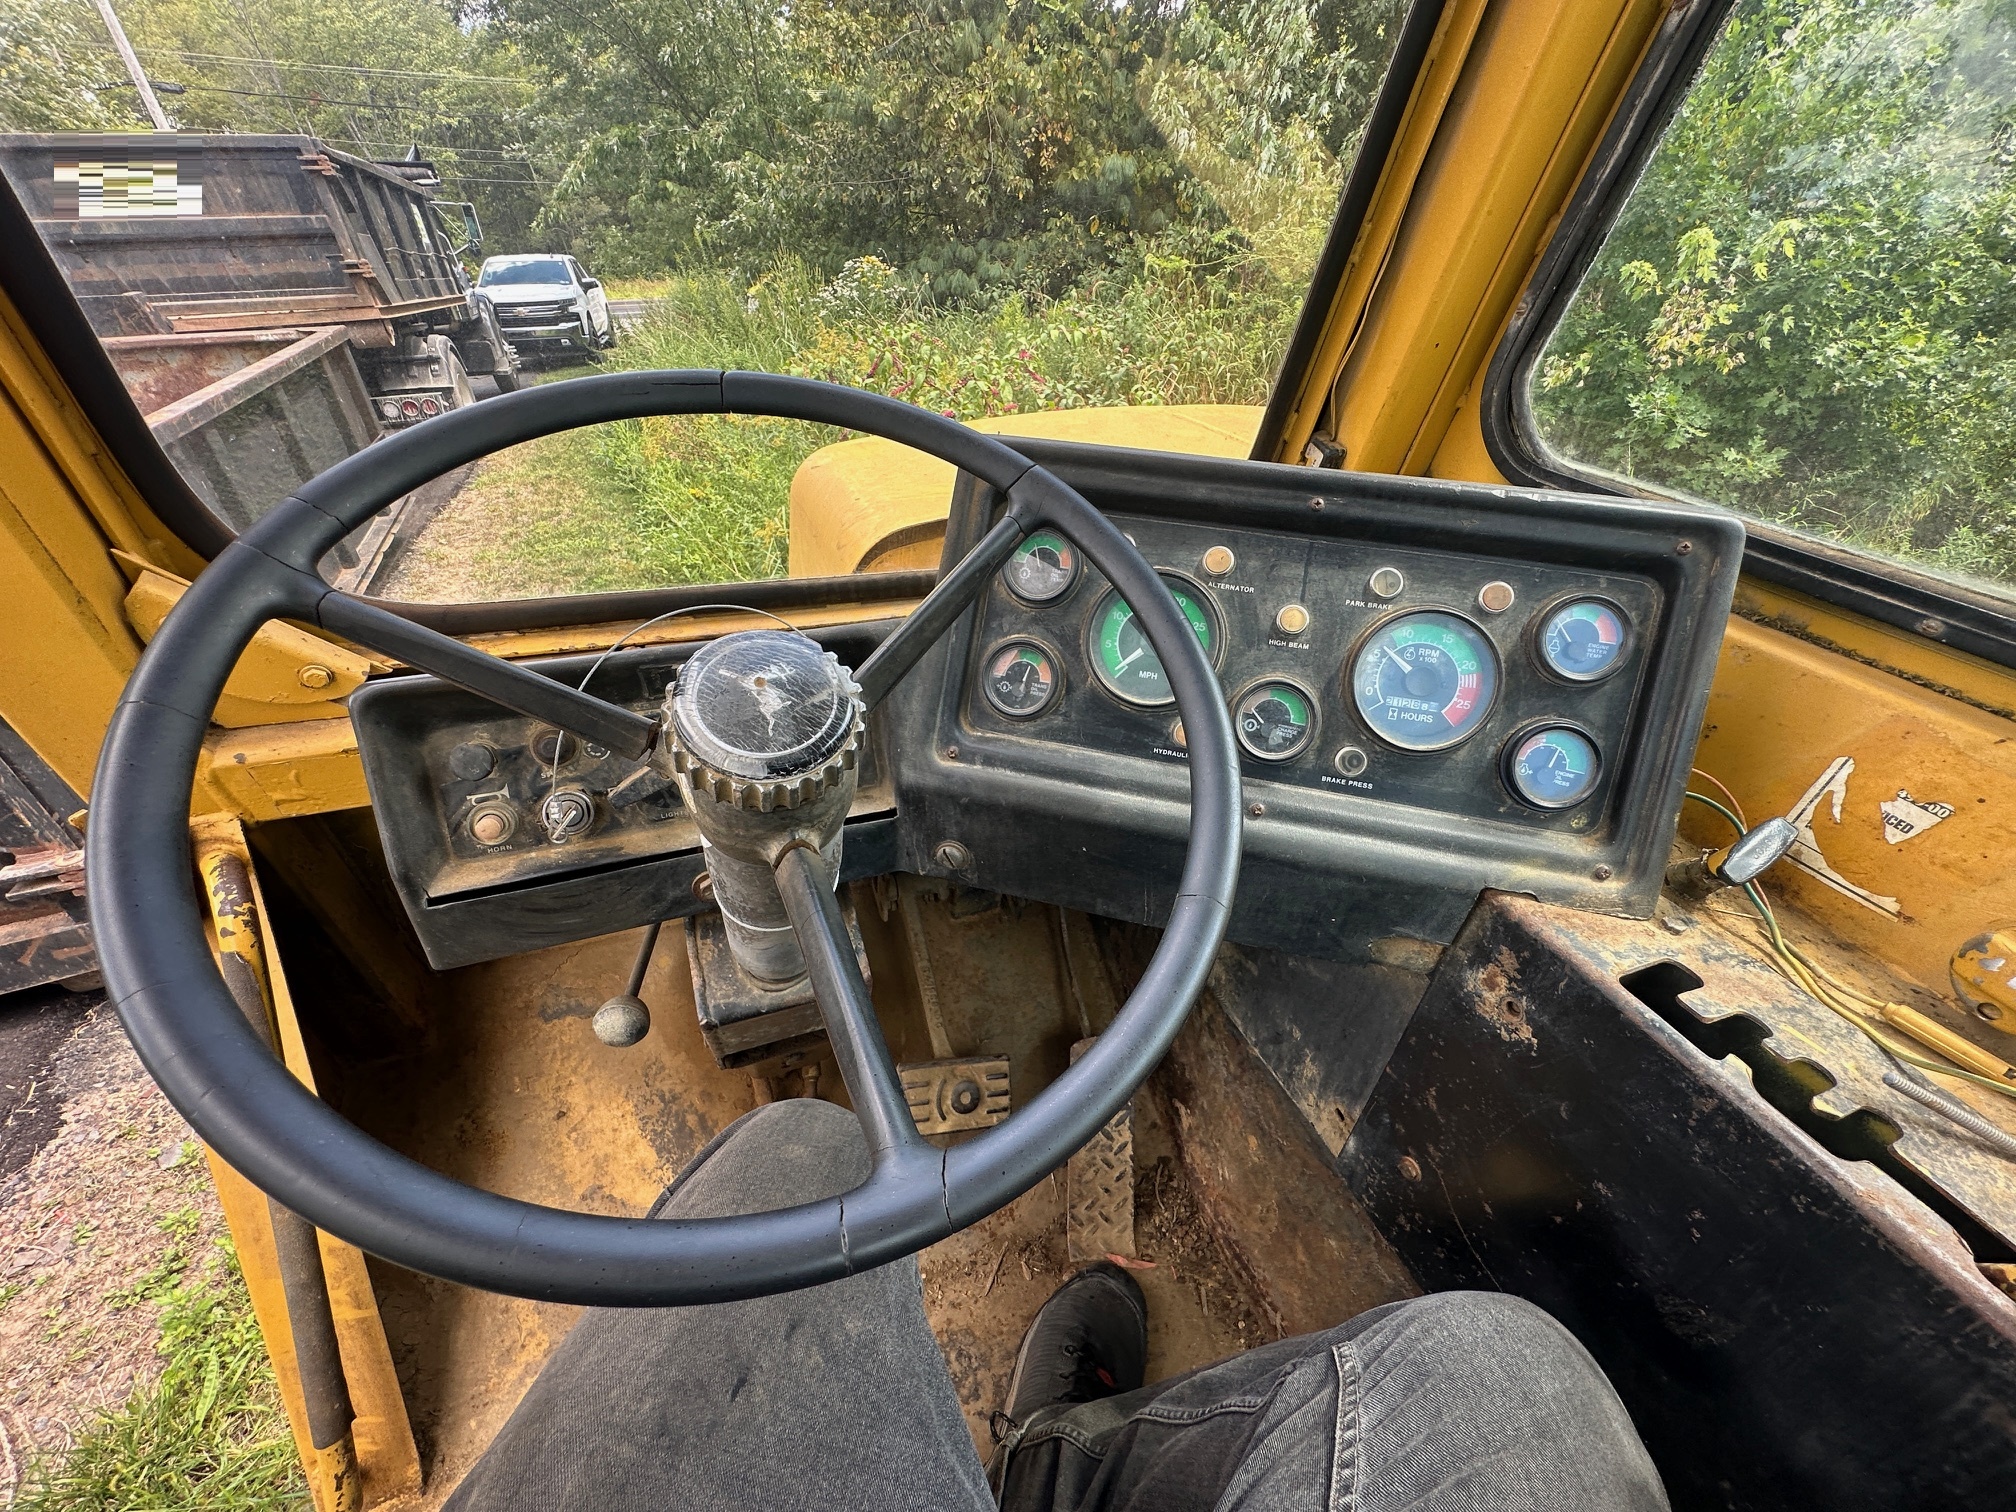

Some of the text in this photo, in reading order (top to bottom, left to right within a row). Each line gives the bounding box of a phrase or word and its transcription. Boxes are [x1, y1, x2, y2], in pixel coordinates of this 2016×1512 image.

[1208, 581, 1255, 593] ALTERNATOR
[1174, 597, 1187, 607] 0
[1345, 599, 1393, 611] PARK BRAKE
[1112, 611, 1124, 621] 10
[1193, 621, 1206, 632] 25
[1402, 629, 1414, 639] 10
[1442, 633, 1455, 644] 15
[1105, 640, 1112, 648] 5
[1268, 639, 1310, 650] HIGH BEAM
[1373, 649, 1381, 658] 5
[1418, 648, 1440, 658] RPM
[1462, 661, 1477, 671] 20
[1138, 670, 1158, 680] MPH
[1365, 686, 1373, 696] 0
[1456, 699, 1471, 710] 25
[1400, 711, 1434, 723] HOURS
[1153, 747, 1188, 758] HYDRAULI
[1321, 775, 1373, 790] BRAKE PRESS
[487, 844, 513, 854] HORN
